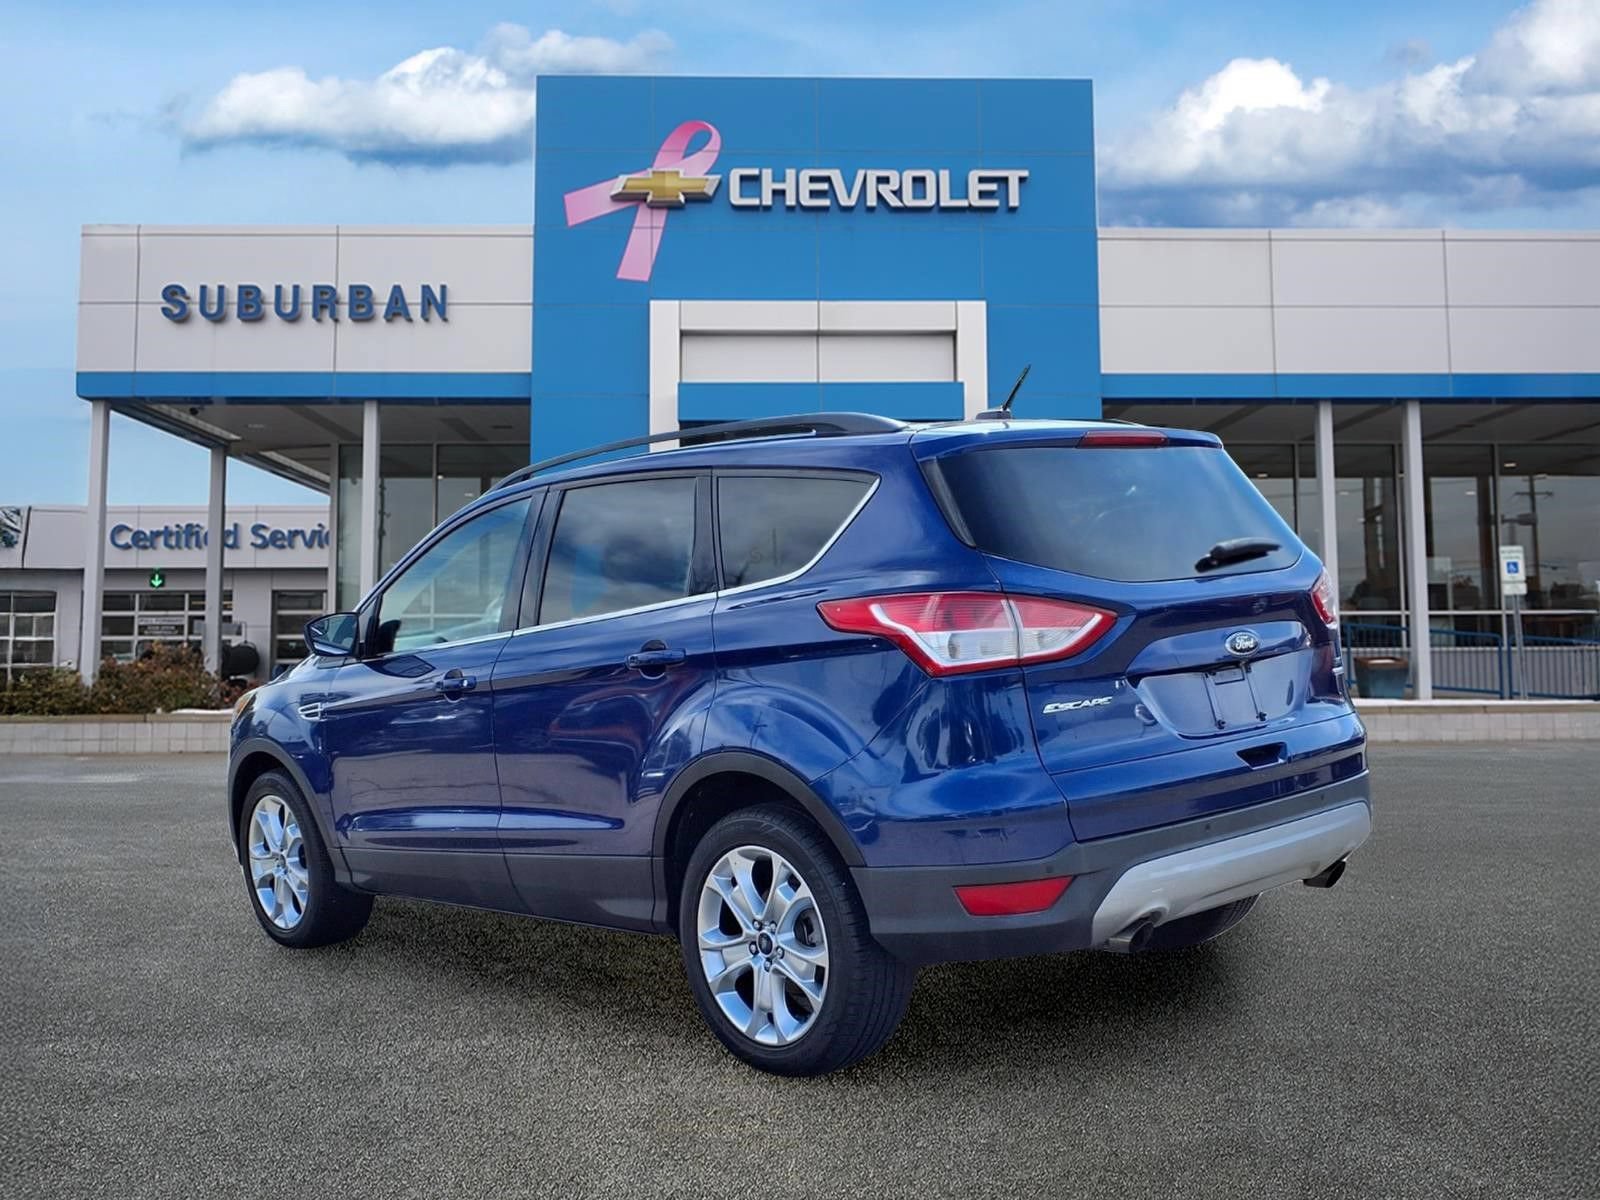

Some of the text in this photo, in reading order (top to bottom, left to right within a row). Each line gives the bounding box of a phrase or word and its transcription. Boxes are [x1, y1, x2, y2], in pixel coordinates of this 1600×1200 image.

[729, 168, 1029, 208] CHEVROLET
[161, 284, 449, 322] SUBURBAN
[110, 523, 240, 549] Certifid
[1235, 635, 1254, 650] Ford
[1043, 696, 1112, 713] ESCAPE
